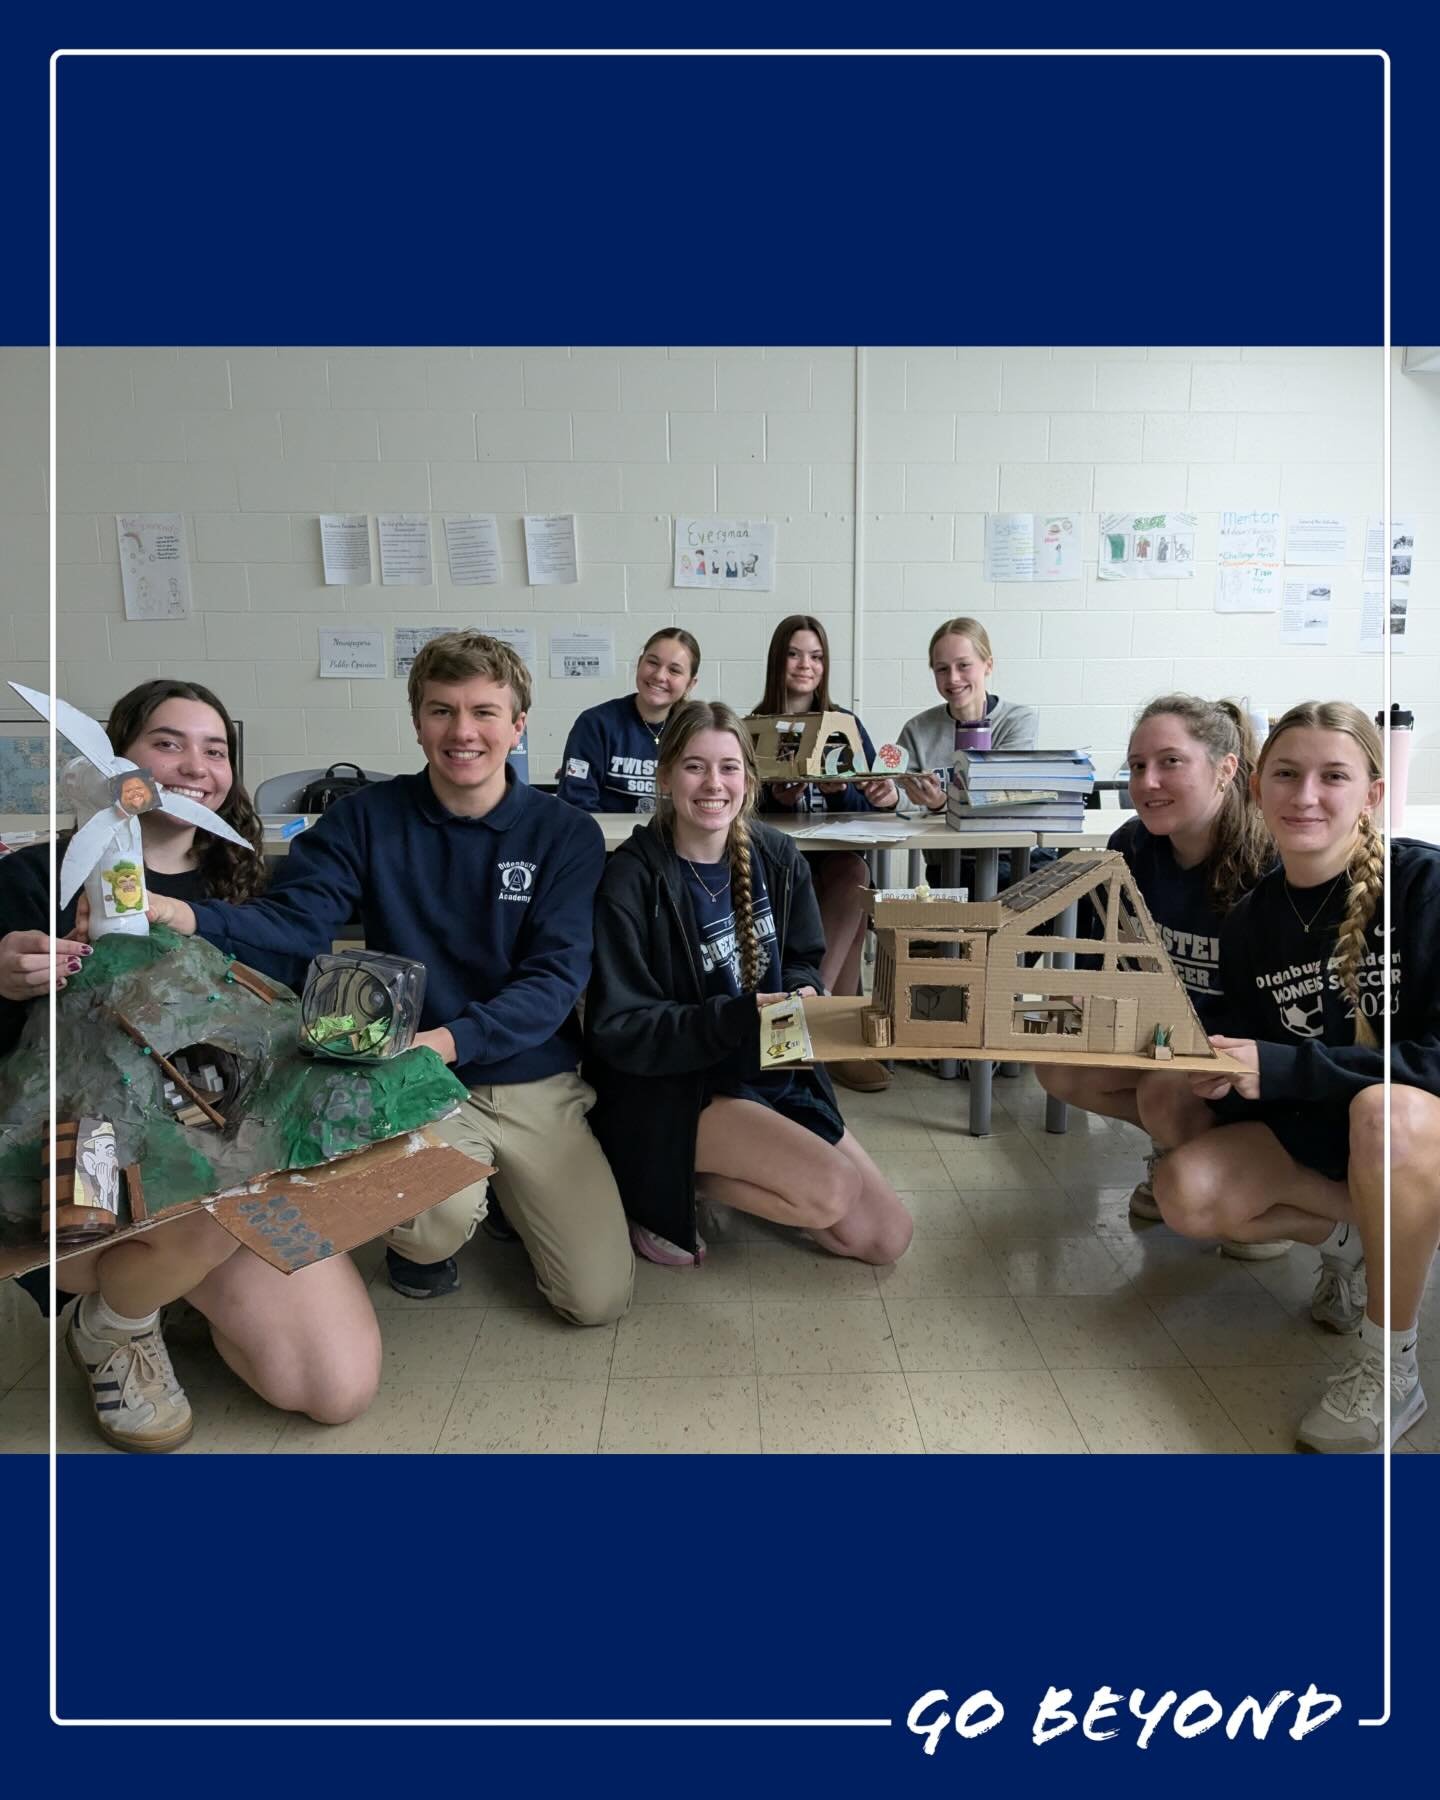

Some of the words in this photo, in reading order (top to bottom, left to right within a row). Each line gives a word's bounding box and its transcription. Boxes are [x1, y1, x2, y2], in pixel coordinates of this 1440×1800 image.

[1223, 510, 1279, 527] Mentor
[688, 520, 751, 546] Everyman
[611, 756, 659, 776] TWIS
[498, 892, 531, 903] Academy
